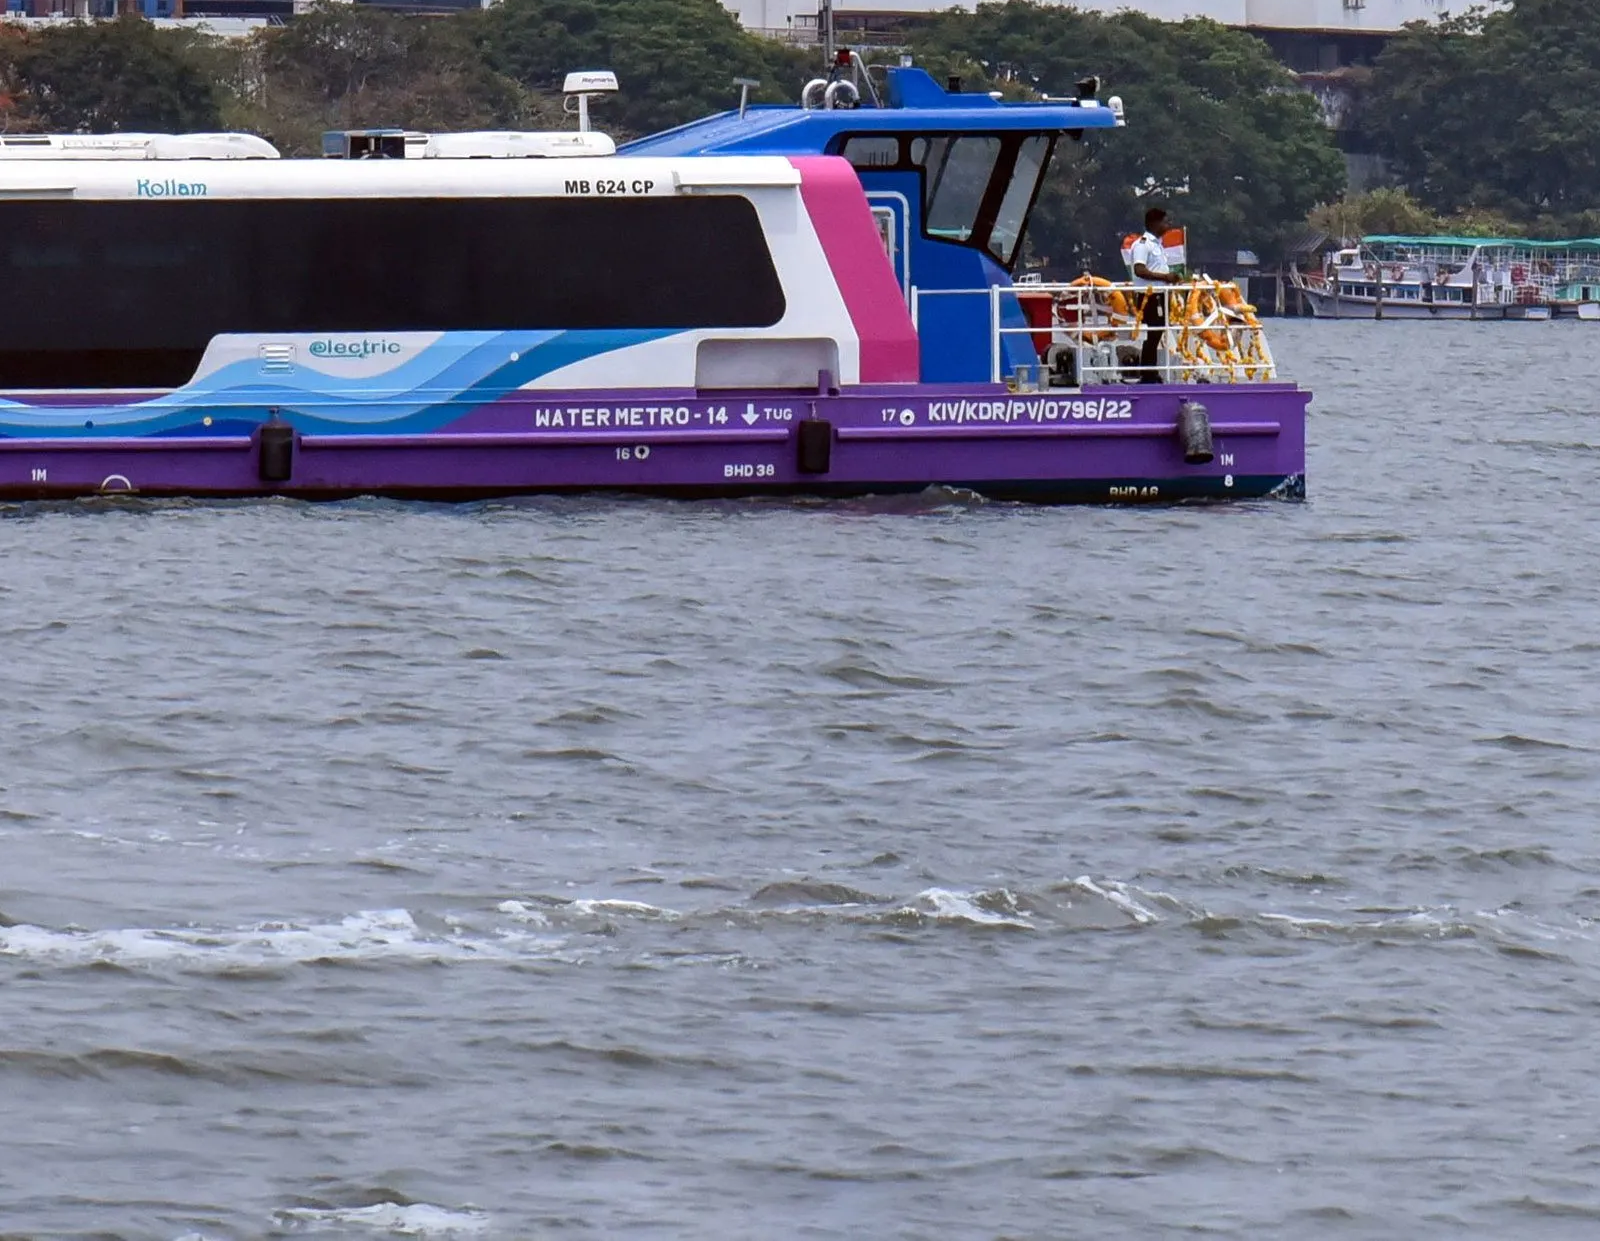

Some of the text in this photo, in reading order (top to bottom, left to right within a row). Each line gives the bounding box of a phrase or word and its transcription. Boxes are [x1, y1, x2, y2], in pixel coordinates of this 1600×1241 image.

[137, 178, 207, 197] Kollam
[564, 180, 654, 194] MB 624 CP
[309, 339, 401, 358] electric
[536, 408, 610, 427] WATER
[615, 407, 690, 426] METRO
[707, 407, 728, 424] 14
[764, 408, 793, 421] TUG
[881, 409, 896, 422] 17
[928, 398, 1132, 423] KIV/KDR/PV/0796/22
[616, 447, 630, 460] 16
[1220, 453, 1234, 466] 1M
[724, 464, 775, 477] BHD 38
[1224, 474, 1234, 487] 8
